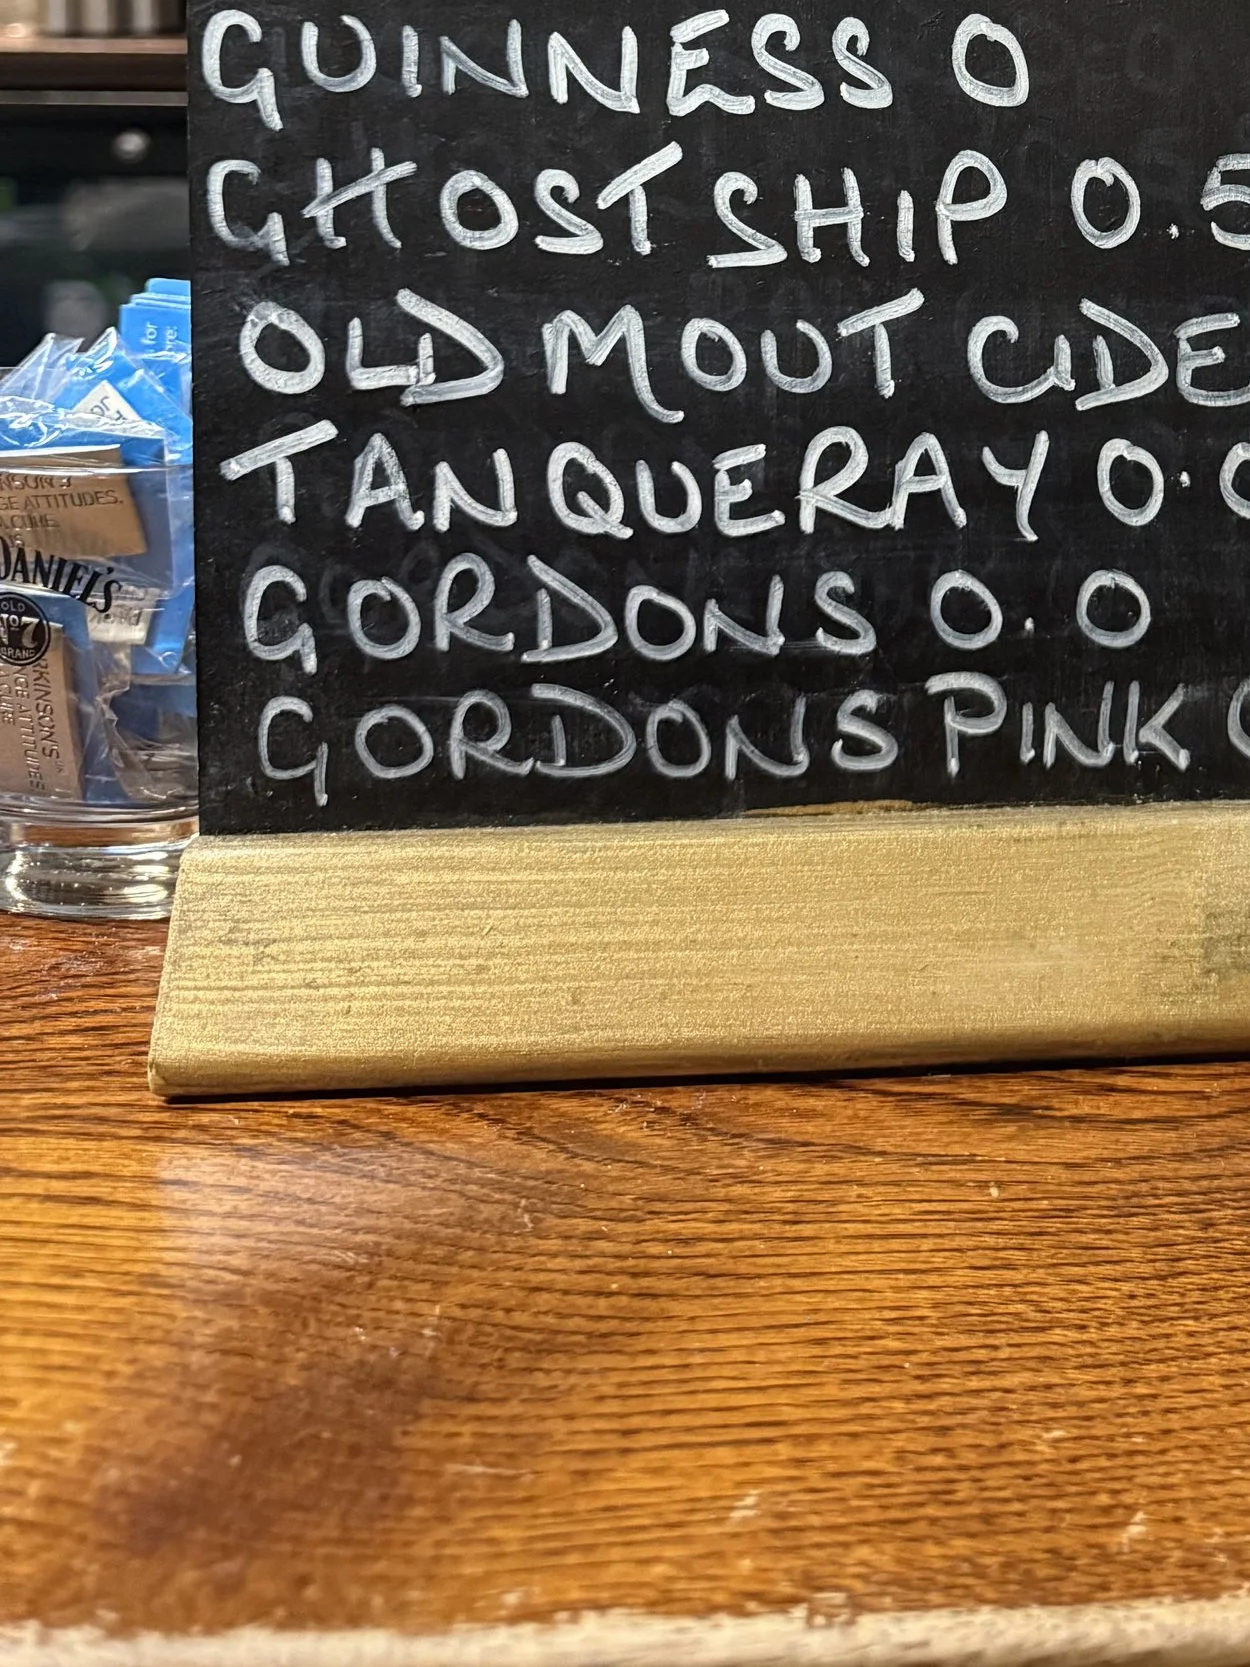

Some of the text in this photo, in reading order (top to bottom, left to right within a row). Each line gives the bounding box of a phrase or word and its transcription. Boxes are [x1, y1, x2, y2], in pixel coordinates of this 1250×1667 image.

[201, 8, 894, 132] GUINNESS
[206, 140, 684, 266] GHOST
[706, 149, 1008, 269] SHIP
[238, 287, 505, 407] OLD
[541, 287, 925, 424] MOUT
[24, 489, 124, 511] ATTITUDES.
[219, 419, 1050, 542] TANQUERAY
[1, 597, 26, 612] OLD
[243, 552, 877, 675] GORDONS
[258, 683, 898, 807] GORDONS
[924, 671, 1191, 778] PINK
